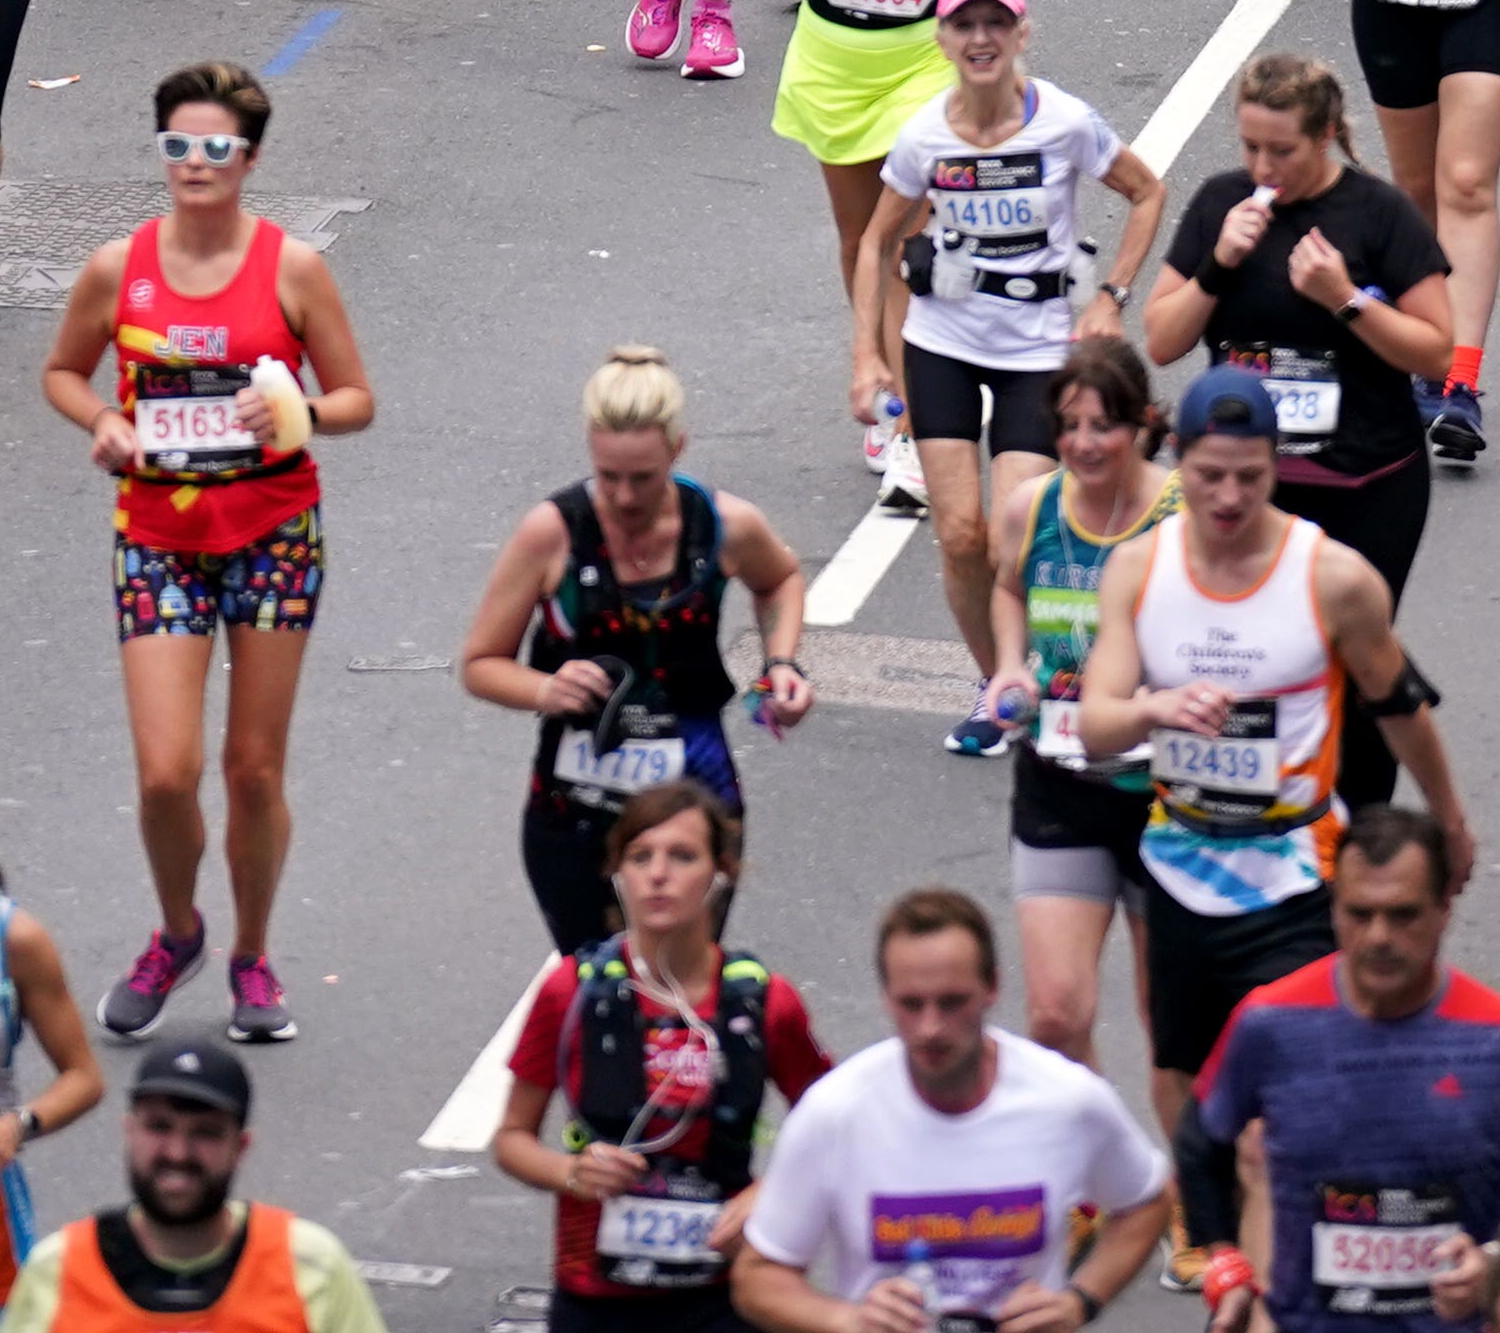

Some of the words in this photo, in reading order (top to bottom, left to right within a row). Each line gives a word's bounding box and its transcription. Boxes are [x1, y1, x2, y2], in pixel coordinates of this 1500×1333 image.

[947, 200, 1032, 226] 14106
[155, 326, 227, 359] JEN
[1166, 738, 1261, 779] 12439
